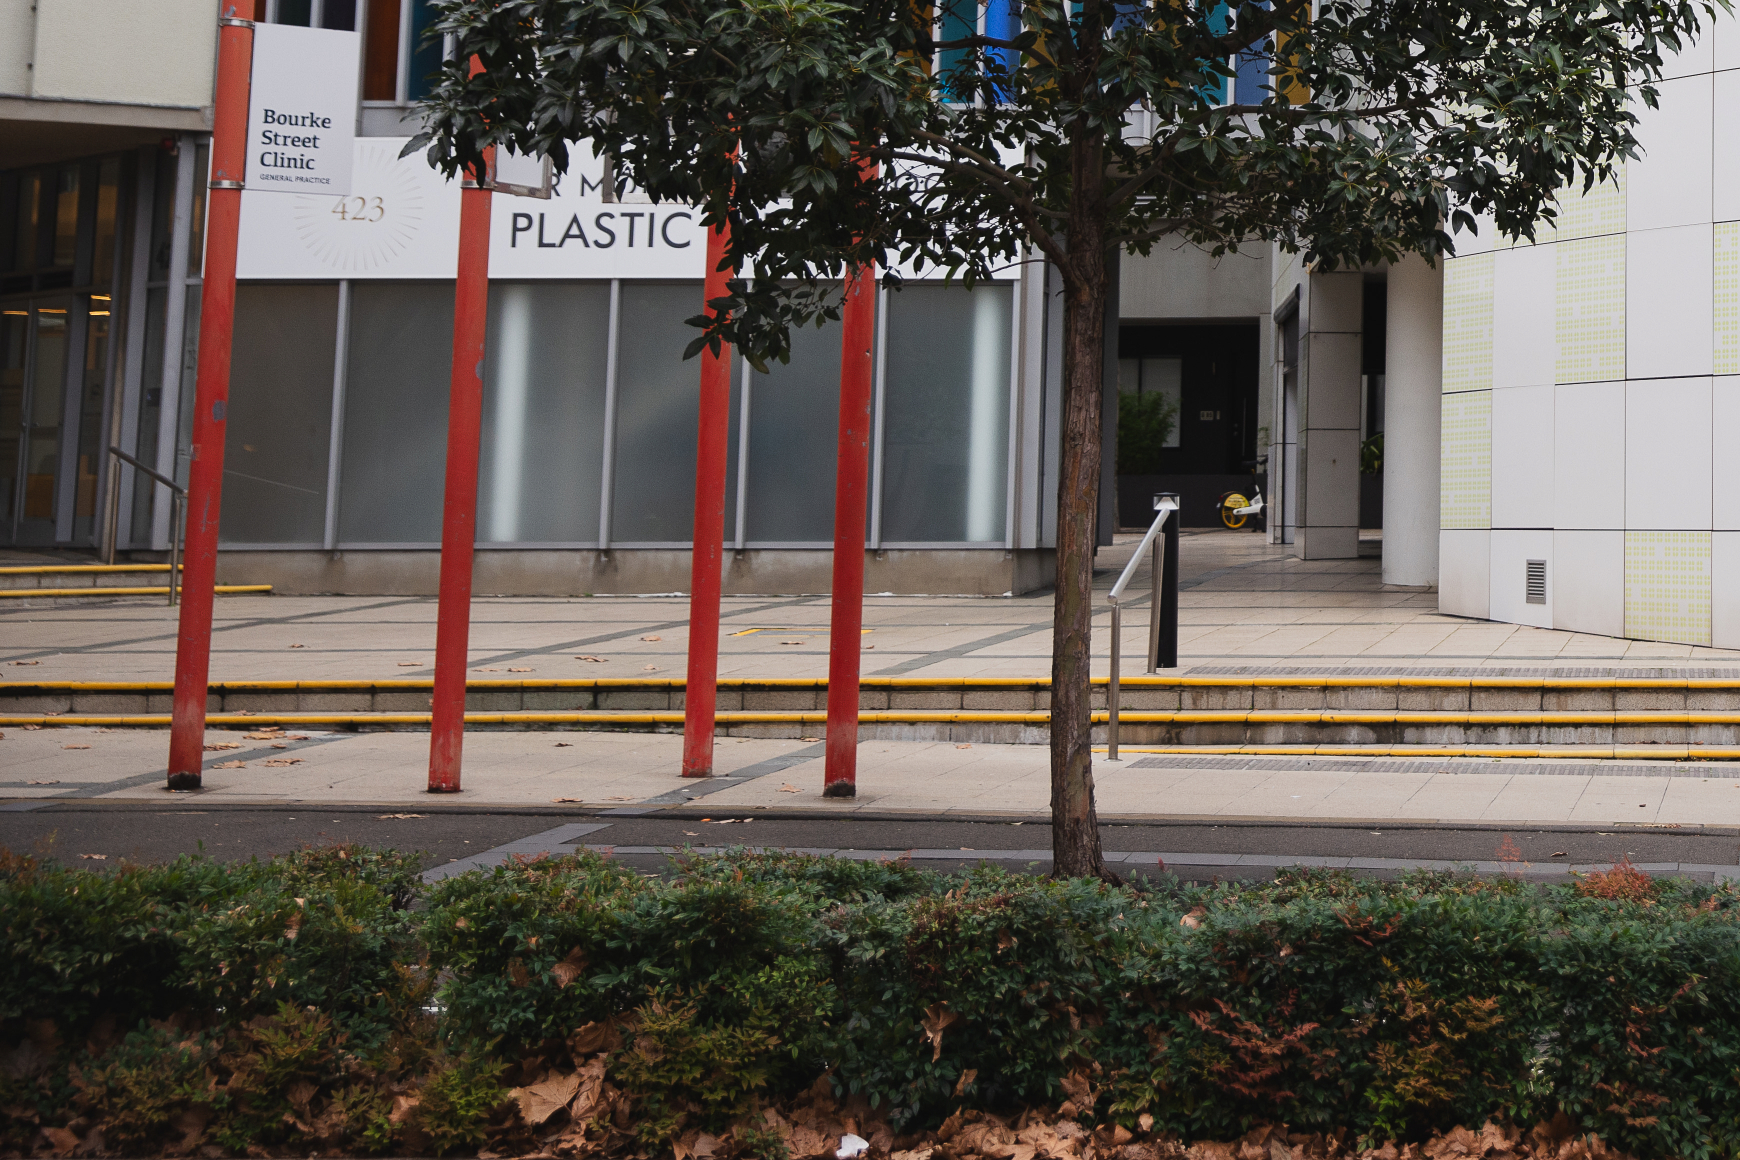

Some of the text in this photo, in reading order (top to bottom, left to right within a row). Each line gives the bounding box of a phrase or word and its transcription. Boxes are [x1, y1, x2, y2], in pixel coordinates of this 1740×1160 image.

[262, 108, 332, 129] Bourke
[261, 129, 321, 149] Street
[259, 151, 316, 170] Clinic
[259, 173, 332, 185] GENERAL PRACTICE
[331, 194, 385, 223] 423
[510, 211, 693, 249] PLASTIC
